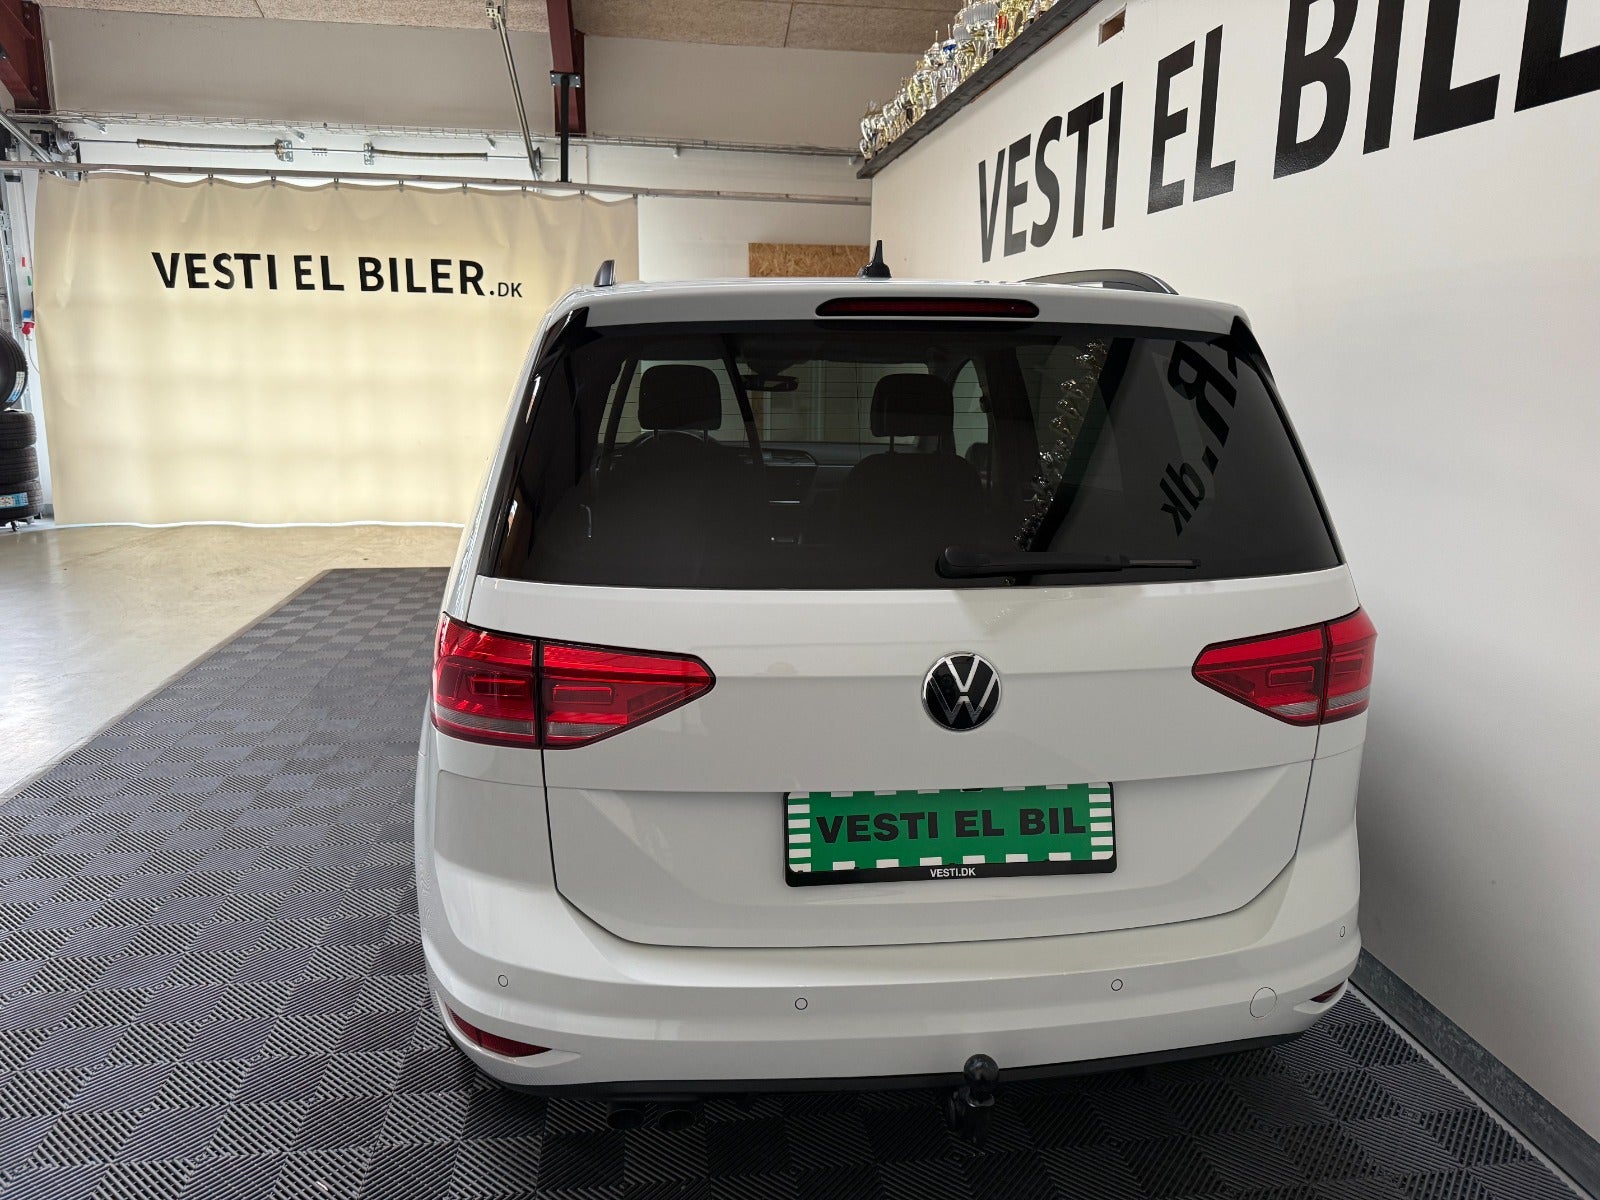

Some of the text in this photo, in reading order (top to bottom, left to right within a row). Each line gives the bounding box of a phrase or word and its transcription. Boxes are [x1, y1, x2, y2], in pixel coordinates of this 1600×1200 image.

[978, 81, 1124, 263] VESTI
[1147, 24, 1236, 215] EL
[152, 251, 278, 290] VESTI
[294, 254, 345, 291] EL
[816, 806, 1087, 844] VESTI EL BIL
[929, 866, 977, 879] VESTI.DK
